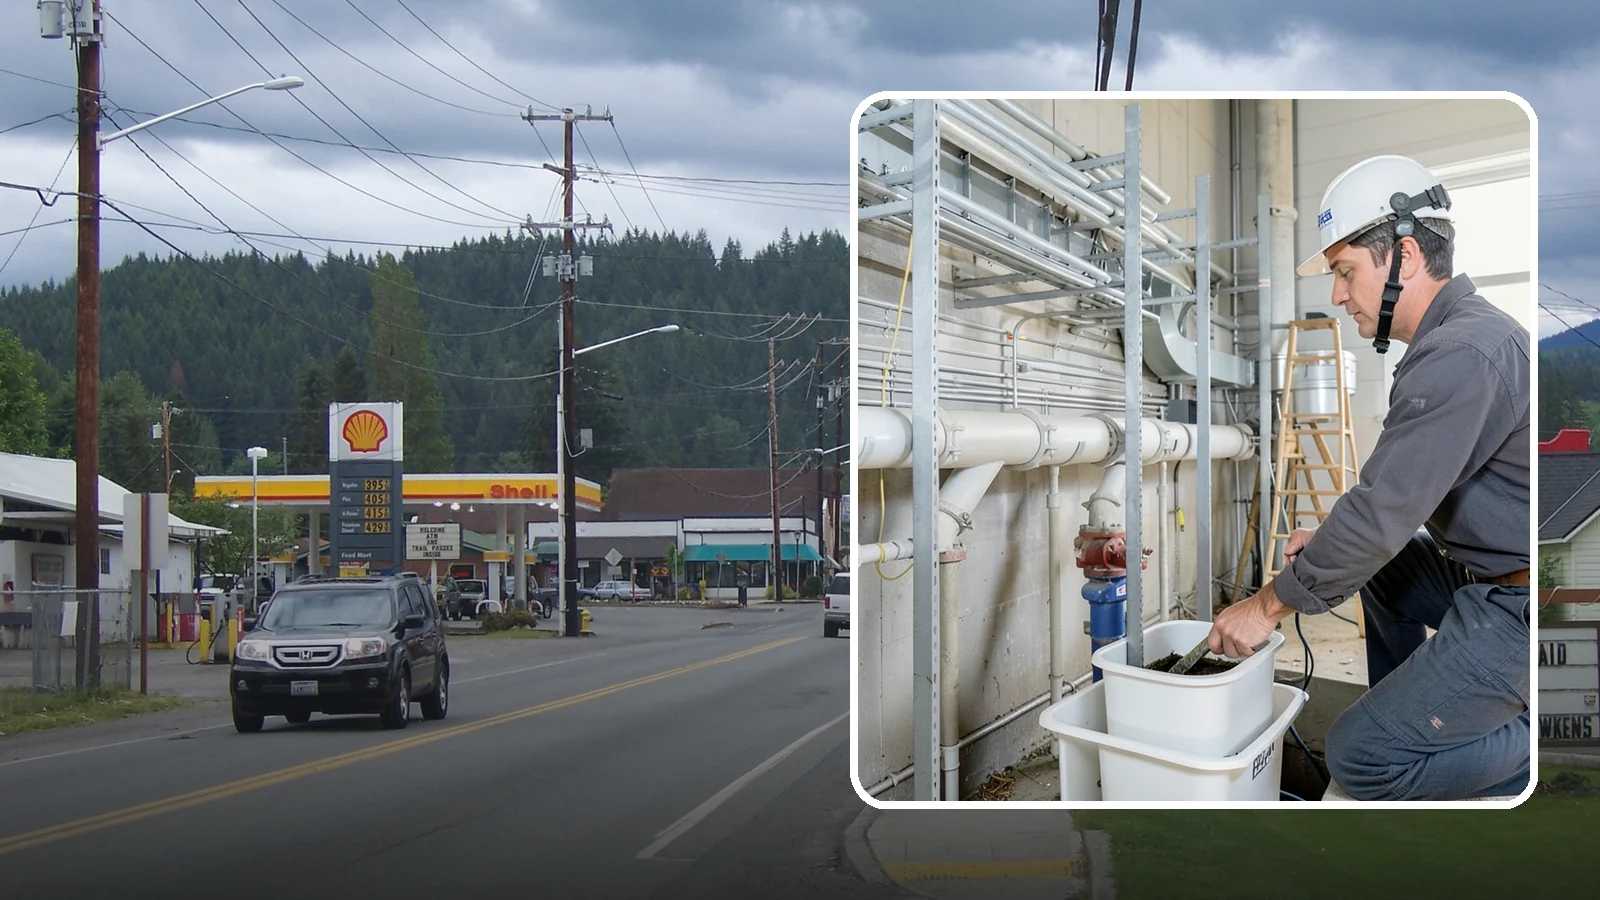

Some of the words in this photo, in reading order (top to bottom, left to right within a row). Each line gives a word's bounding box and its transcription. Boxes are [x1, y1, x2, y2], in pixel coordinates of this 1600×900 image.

[365, 480, 384, 490] 395
[490, 484, 547, 499] Shell
[365, 494, 384, 504] 405
[365, 508, 384, 518] 415
[365, 522, 384, 532] 429
